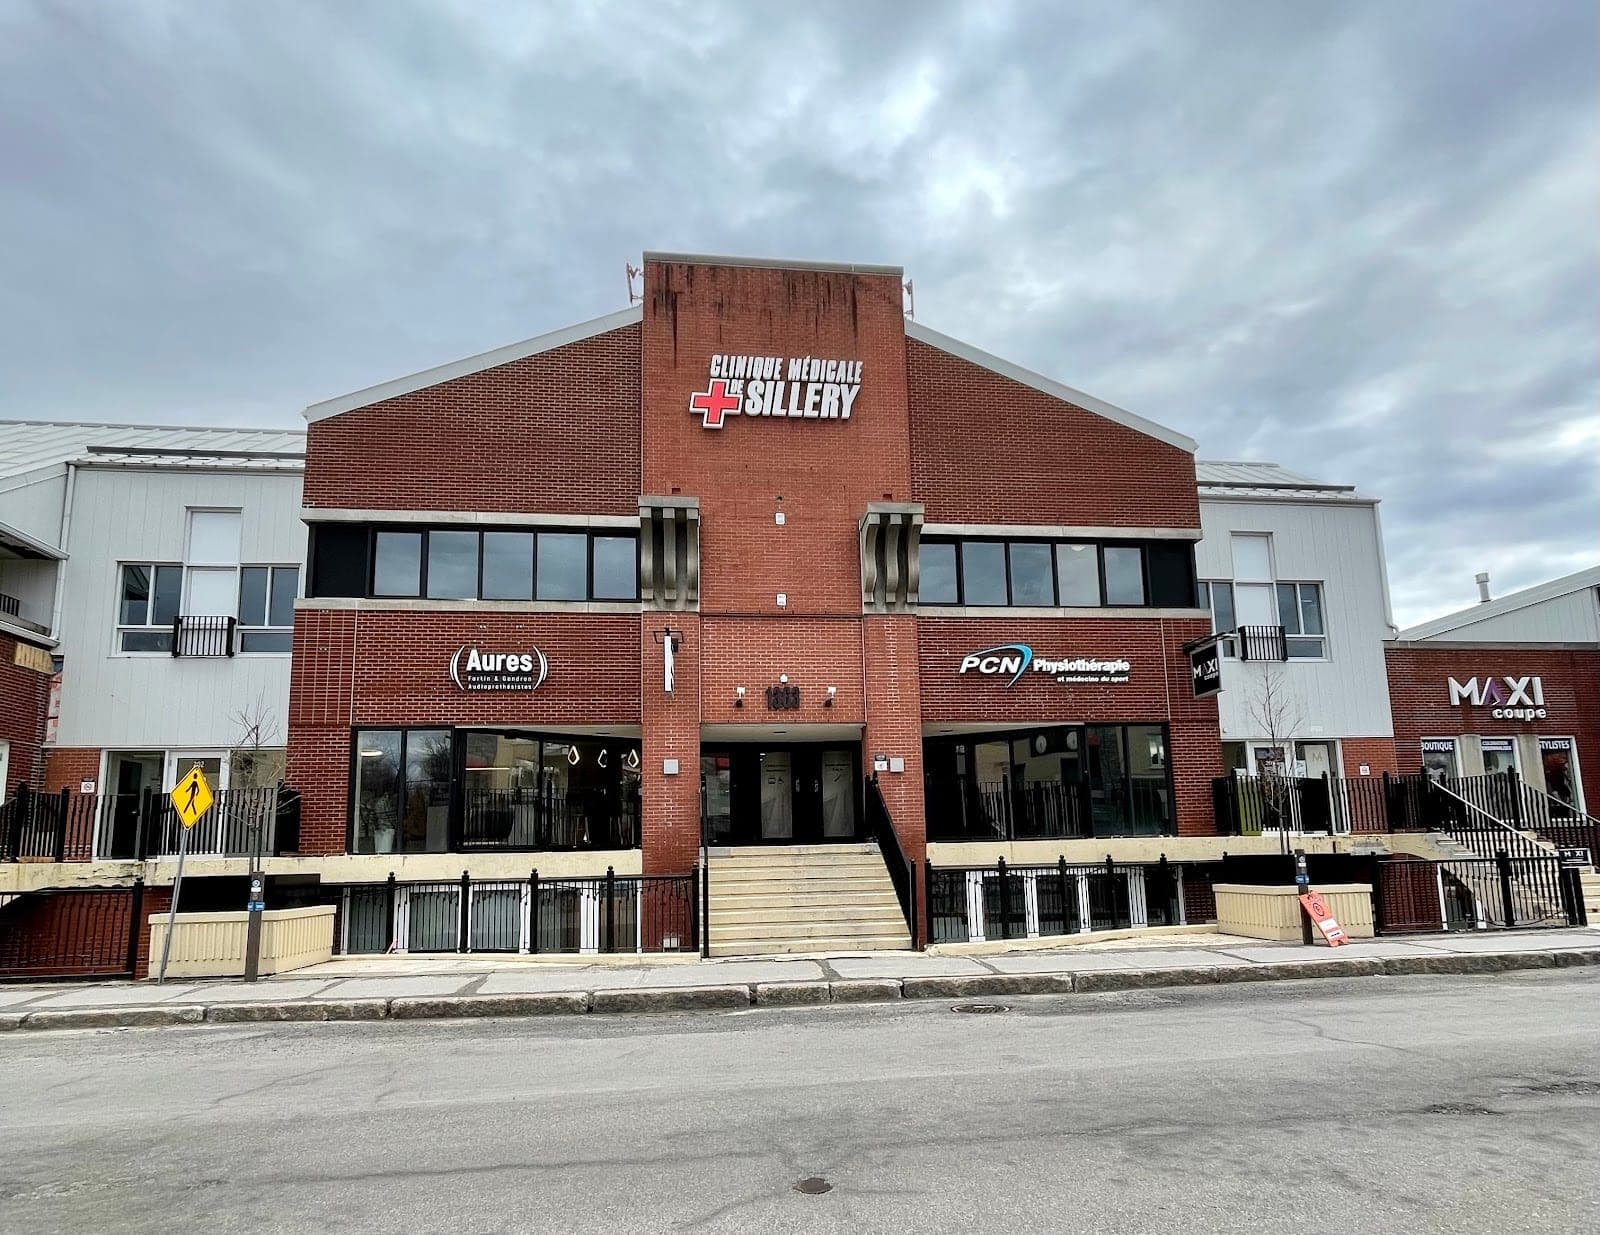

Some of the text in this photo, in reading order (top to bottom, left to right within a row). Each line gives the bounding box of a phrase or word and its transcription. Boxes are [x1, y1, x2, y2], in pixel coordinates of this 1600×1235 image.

[710, 354, 863, 384] CLINIQUE MÉDICALE
[730, 379, 861, 419] DE SILLERY
[466, 649, 533, 672] Aures
[959, 656, 1022, 674] PCN
[1033, 658, 1130, 674] Physiothérapie
[1065, 675, 1100, 683] médecine
[1111, 675, 1129, 684] sport
[1447, 676, 1545, 706] MAXI
[1492, 708, 1547, 721] coupe
